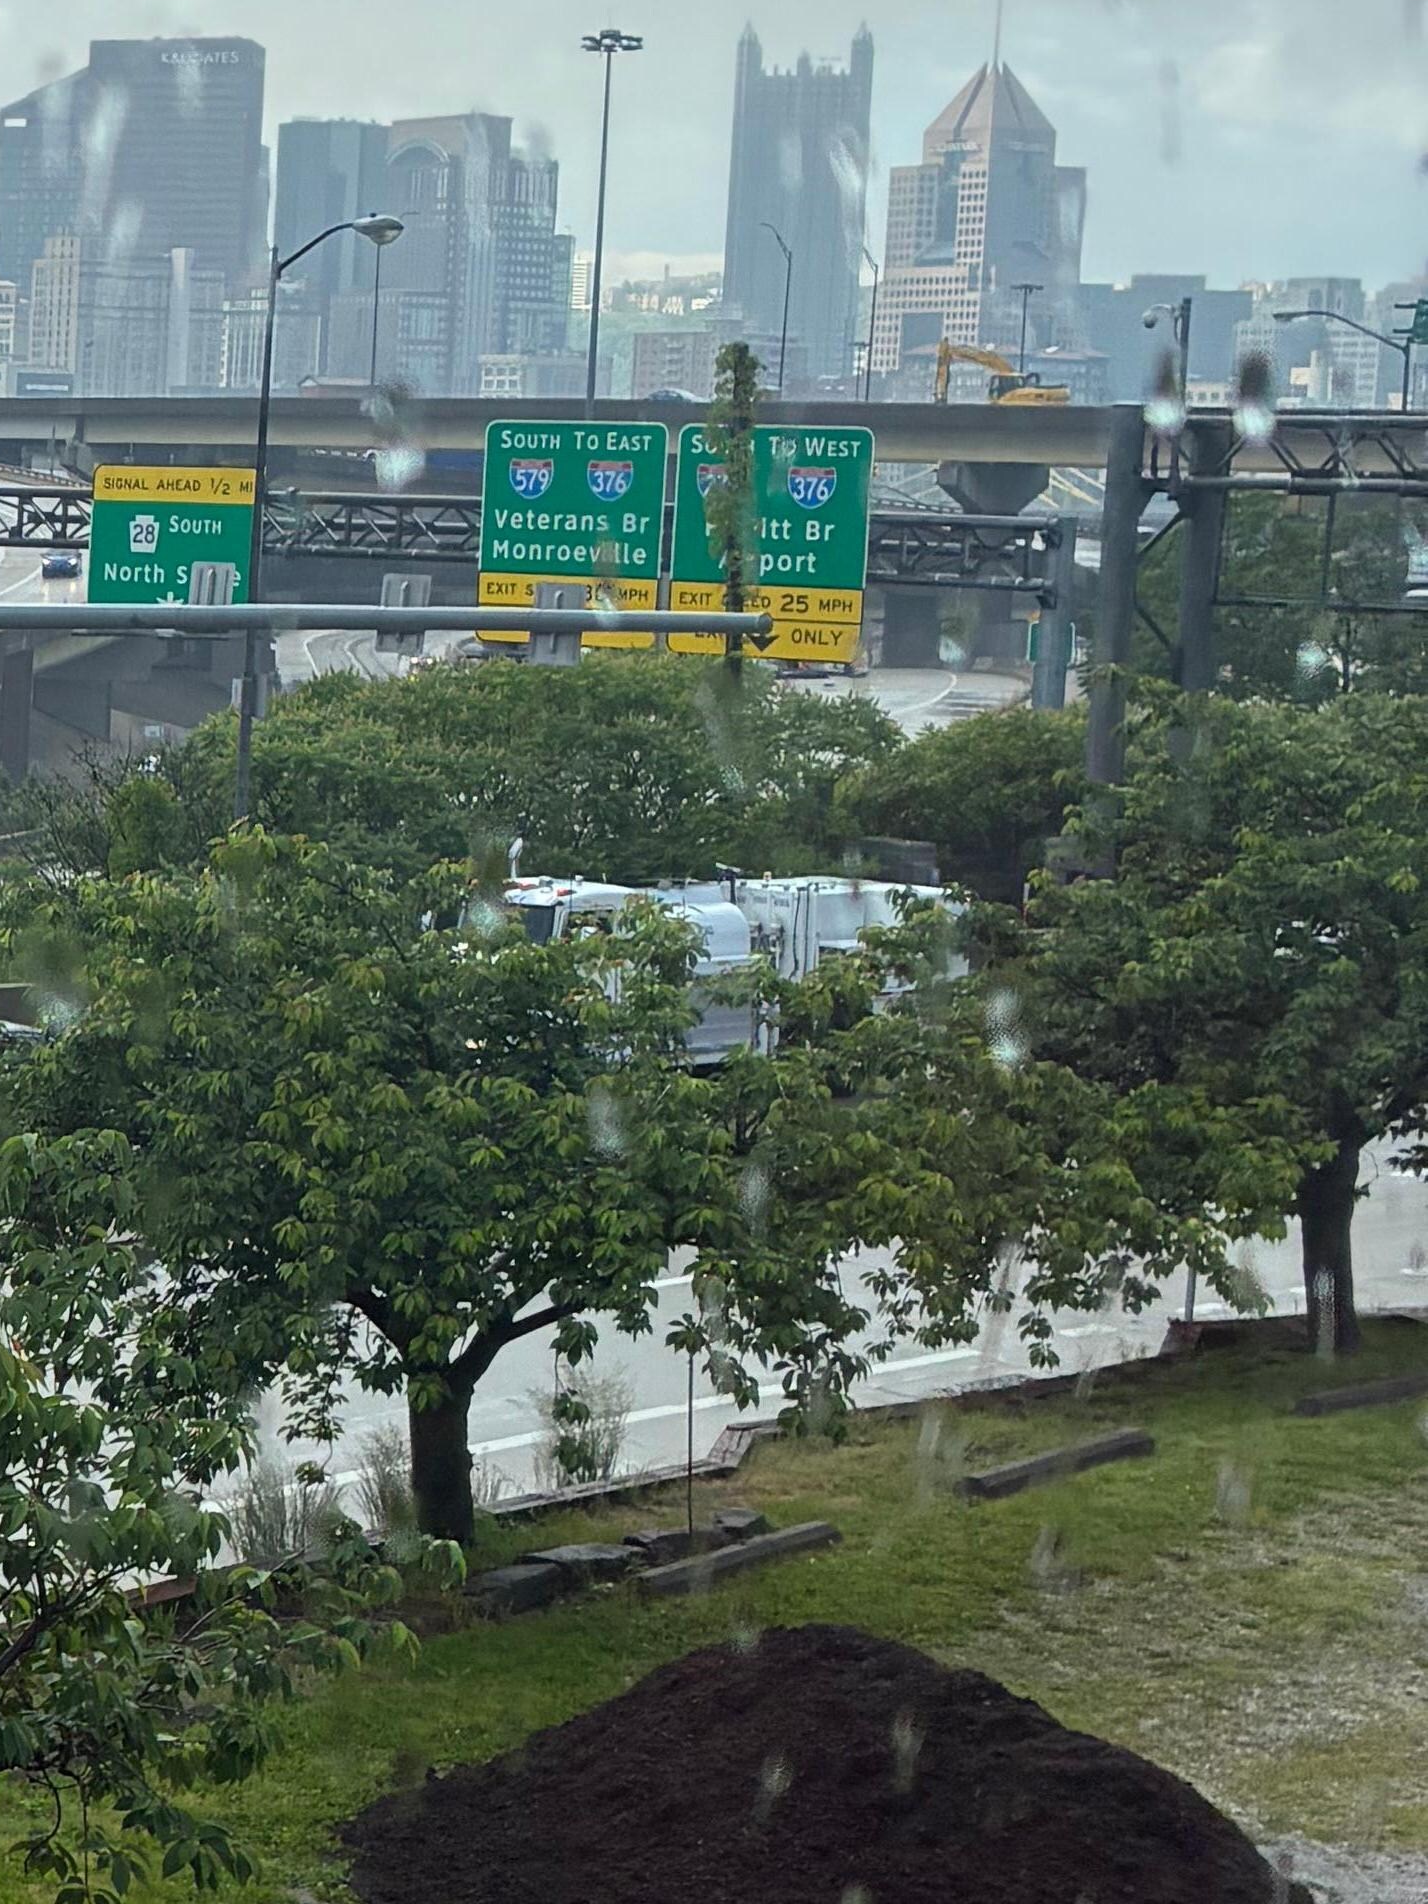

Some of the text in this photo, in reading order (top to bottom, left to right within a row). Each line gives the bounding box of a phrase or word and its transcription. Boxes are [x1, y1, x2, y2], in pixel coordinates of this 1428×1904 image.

[501, 430, 652, 451] SOUTH TO EAST
[805, 437, 861, 458] WEST
[103, 477, 254, 496] SIGNAL AHEAD 1/2 MI
[515, 469, 627, 493] 579 376
[794, 477, 829, 500] 376
[133, 515, 222, 544] 28 SOUTH
[494, 509, 650, 534] Veterans Br
[805, 520, 835, 541] Br
[104, 563, 164, 584] North
[486, 582, 516, 595] EXIT
[679, 591, 713, 606] EXIT
[780, 594, 809, 613] 25
[818, 599, 853, 613] MPH
[791, 627, 843, 646] ONLY
